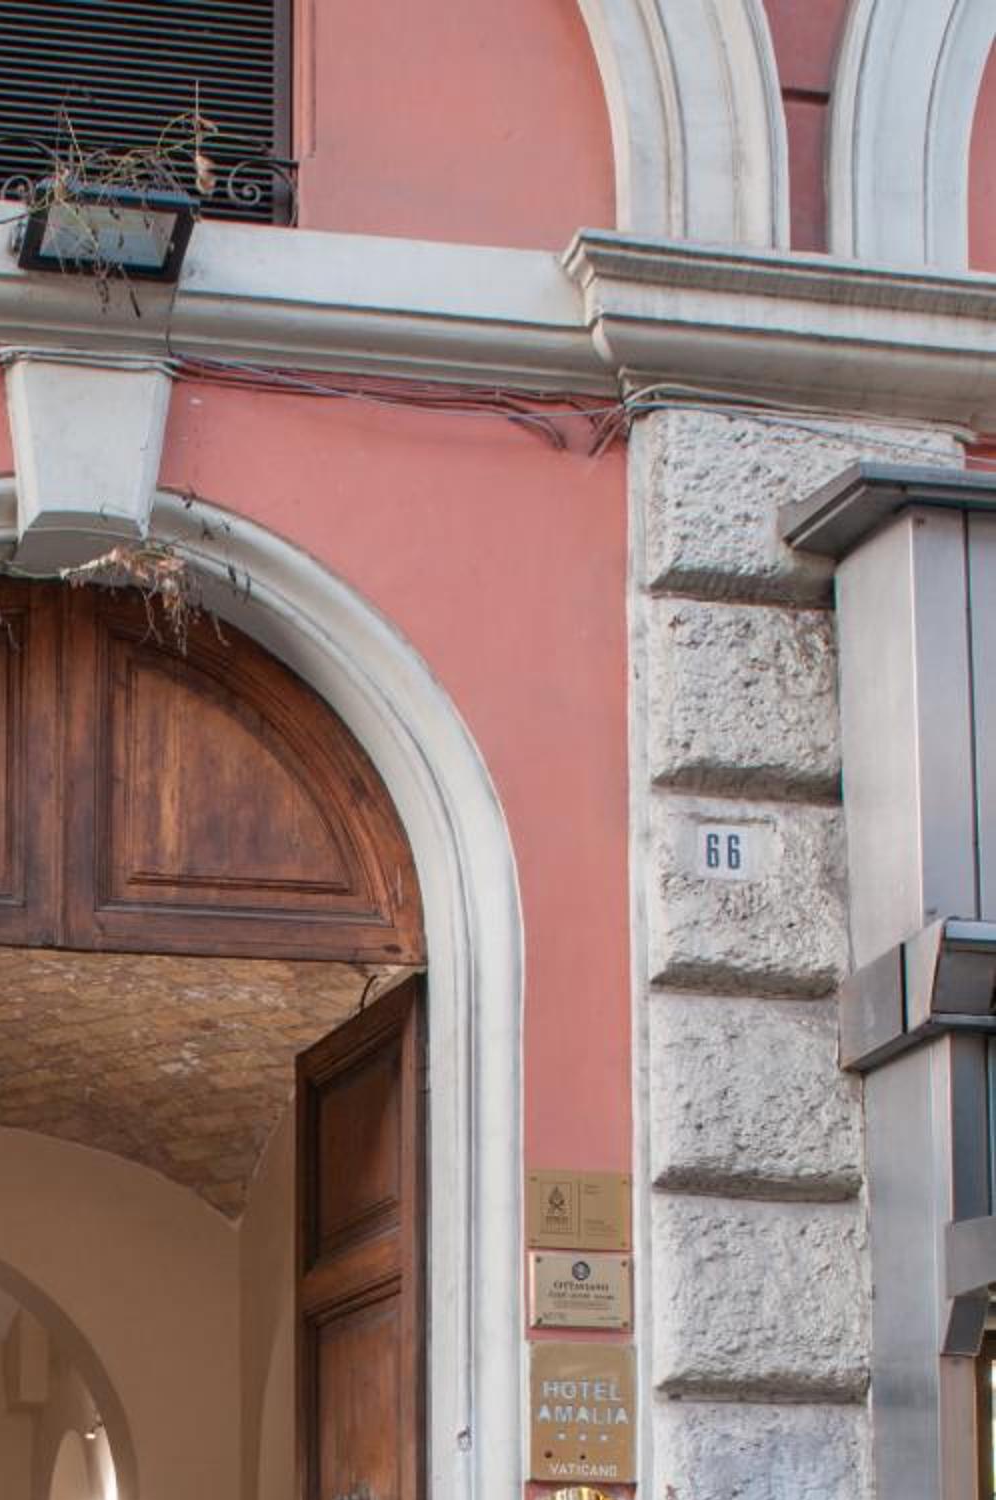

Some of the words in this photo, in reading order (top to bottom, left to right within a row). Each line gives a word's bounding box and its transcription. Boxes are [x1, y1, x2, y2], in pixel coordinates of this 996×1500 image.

[706, 832, 741, 870] 66
[540, 1379, 621, 1402] HOTEL
[539, 1405, 629, 1425] AMALIA
[549, 1463, 618, 1478] VATICANO
